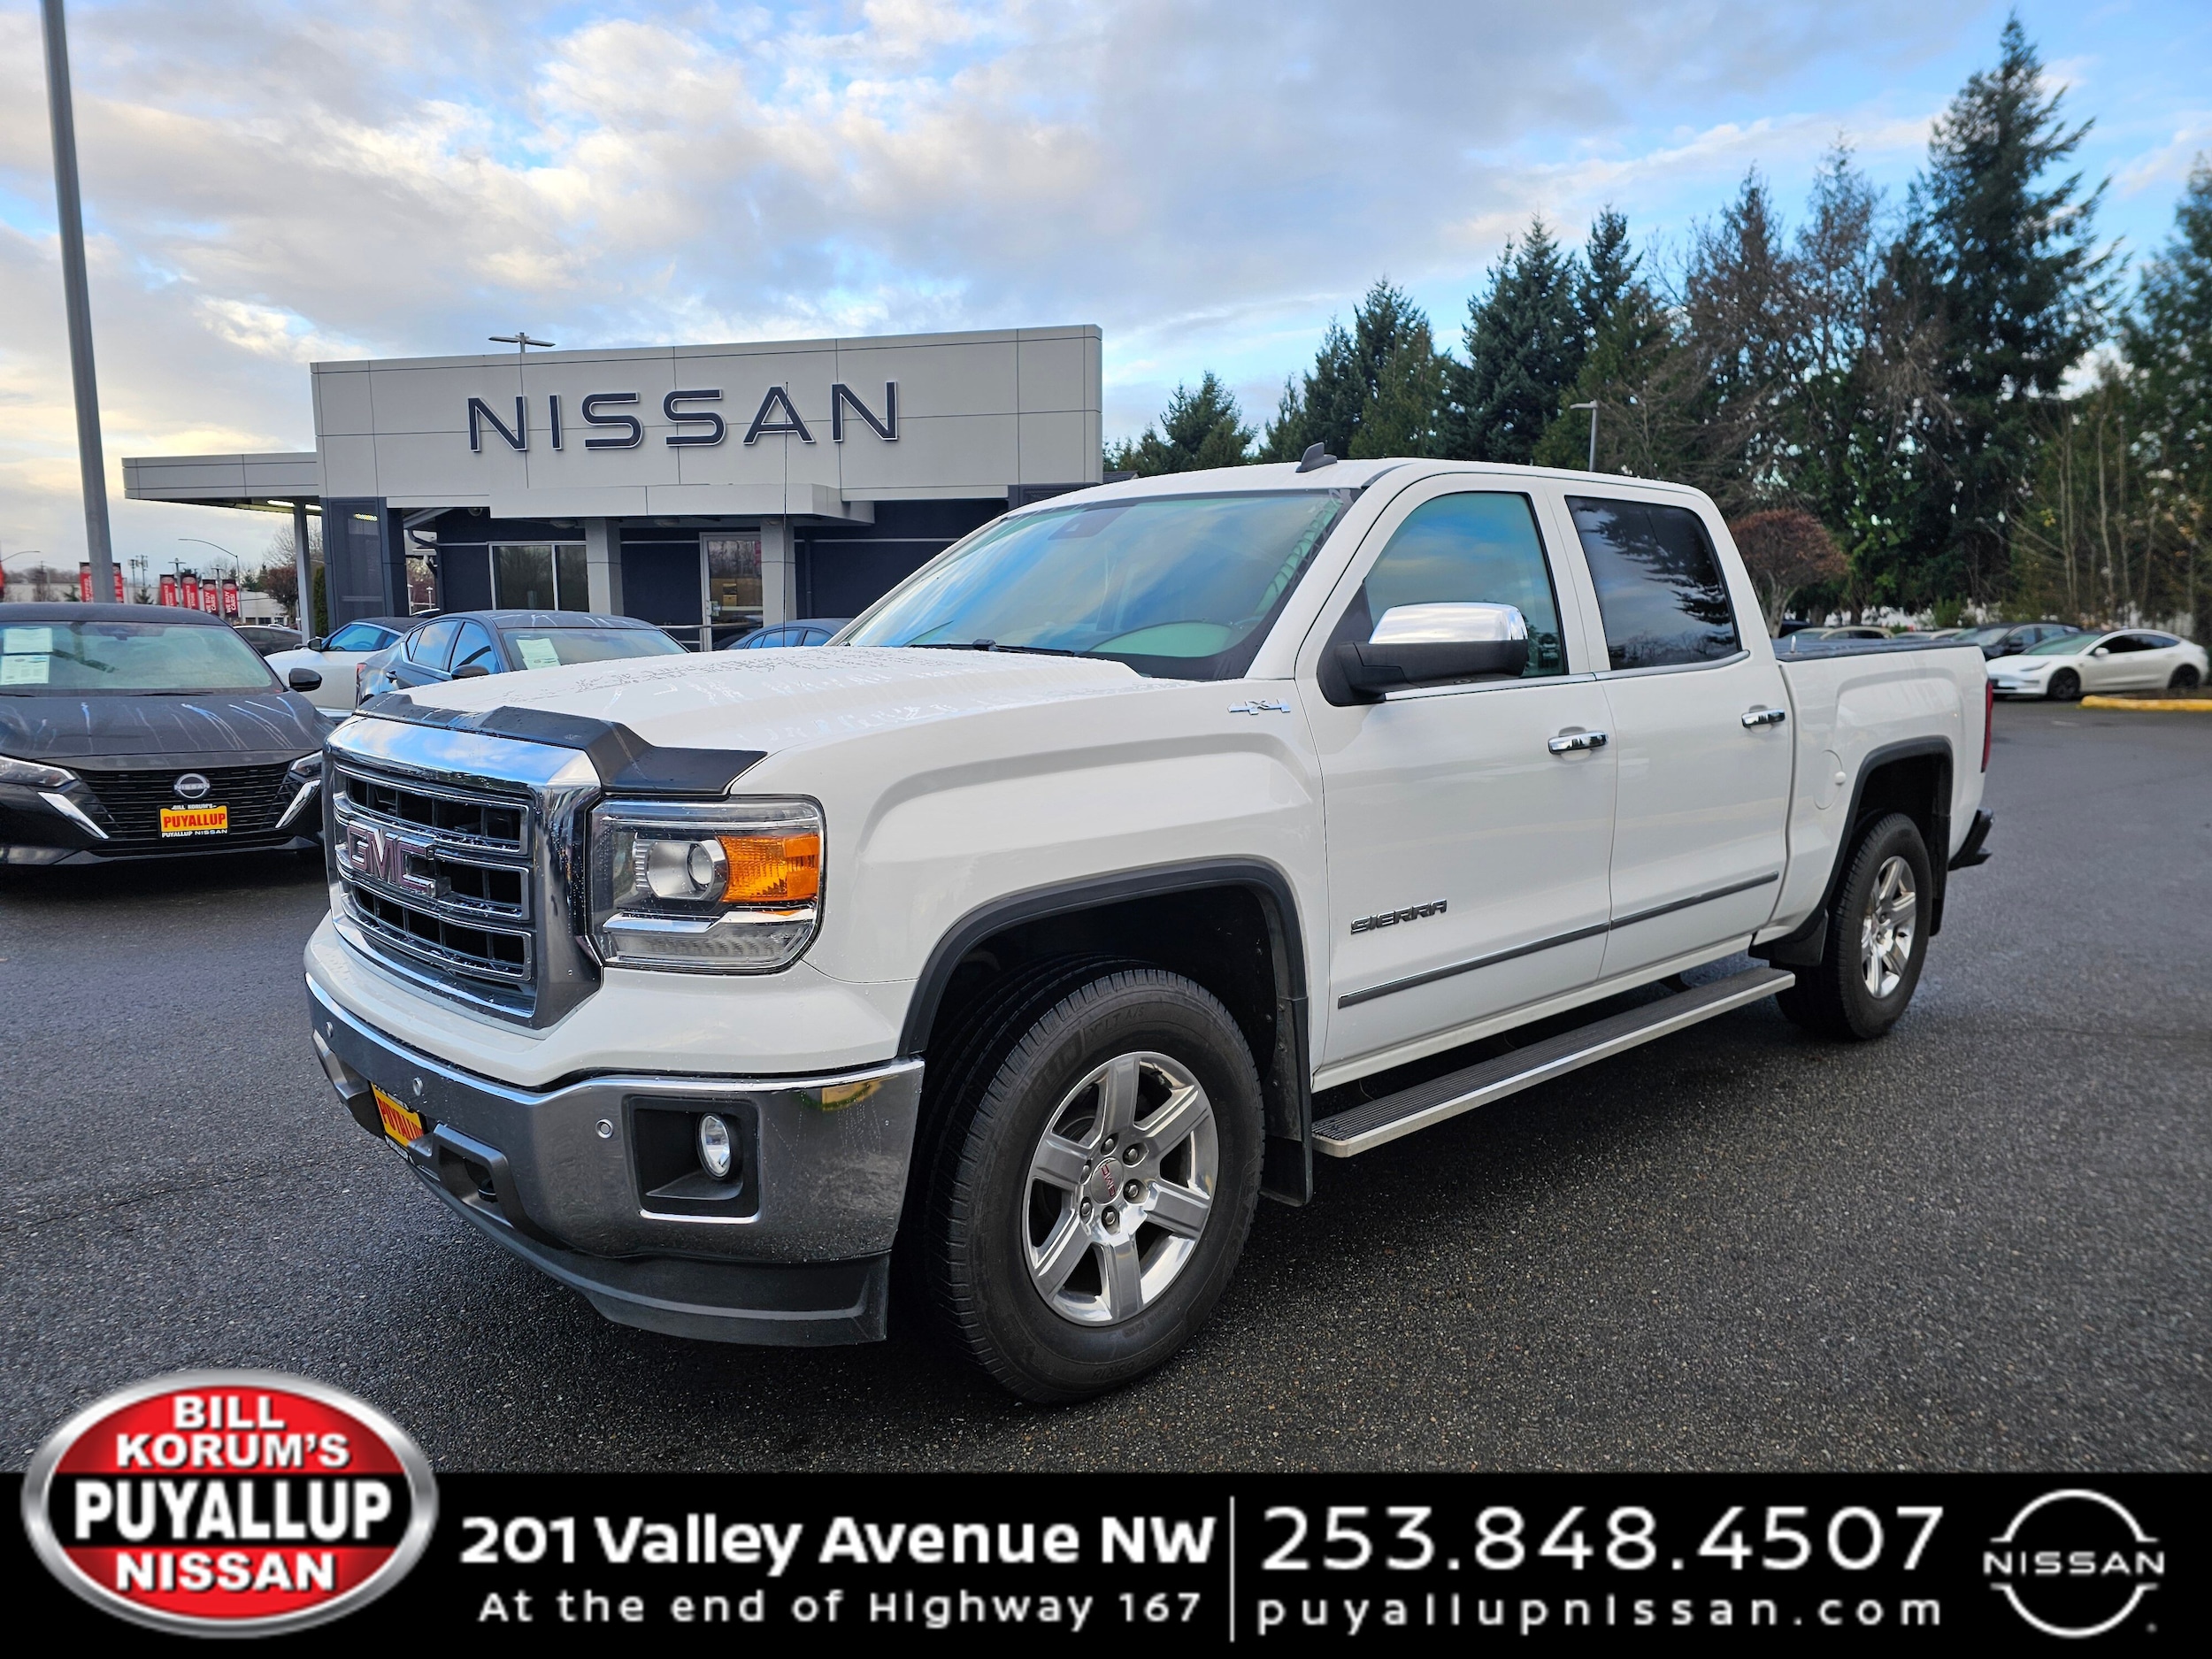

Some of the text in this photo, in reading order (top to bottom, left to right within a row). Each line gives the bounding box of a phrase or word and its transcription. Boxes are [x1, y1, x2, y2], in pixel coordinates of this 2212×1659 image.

[467, 381, 898, 452] NISSAN
[163, 812, 227, 828] PUYALLUP
[347, 819, 436, 898] GMC
[1350, 898, 1448, 935] SIERRA
[1101, 1163, 1117, 1198] GMC
